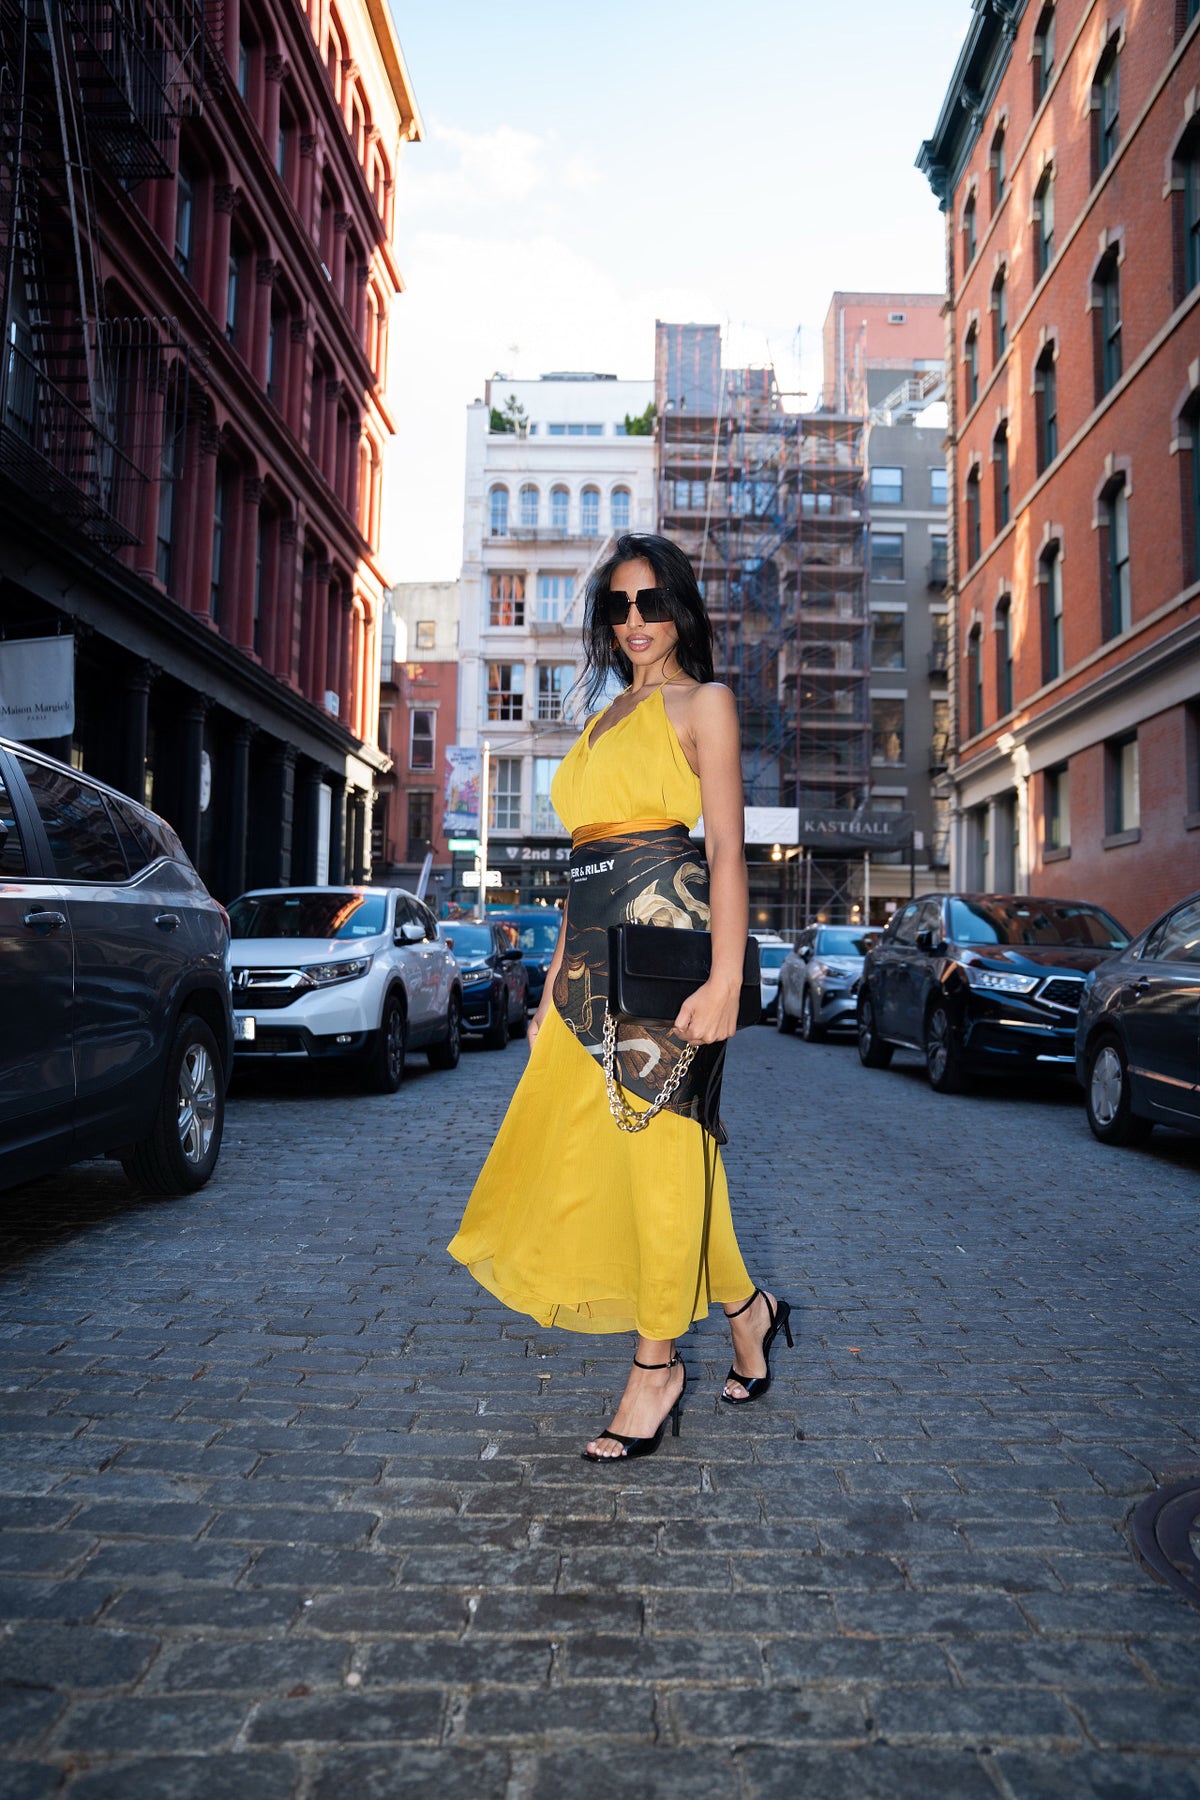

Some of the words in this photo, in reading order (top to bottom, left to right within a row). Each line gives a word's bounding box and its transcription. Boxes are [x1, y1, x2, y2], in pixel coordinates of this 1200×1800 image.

[2, 704, 32, 716] Maison
[804, 821, 892, 834] KASTHALL
[521, 847, 551, 861] 2nd
